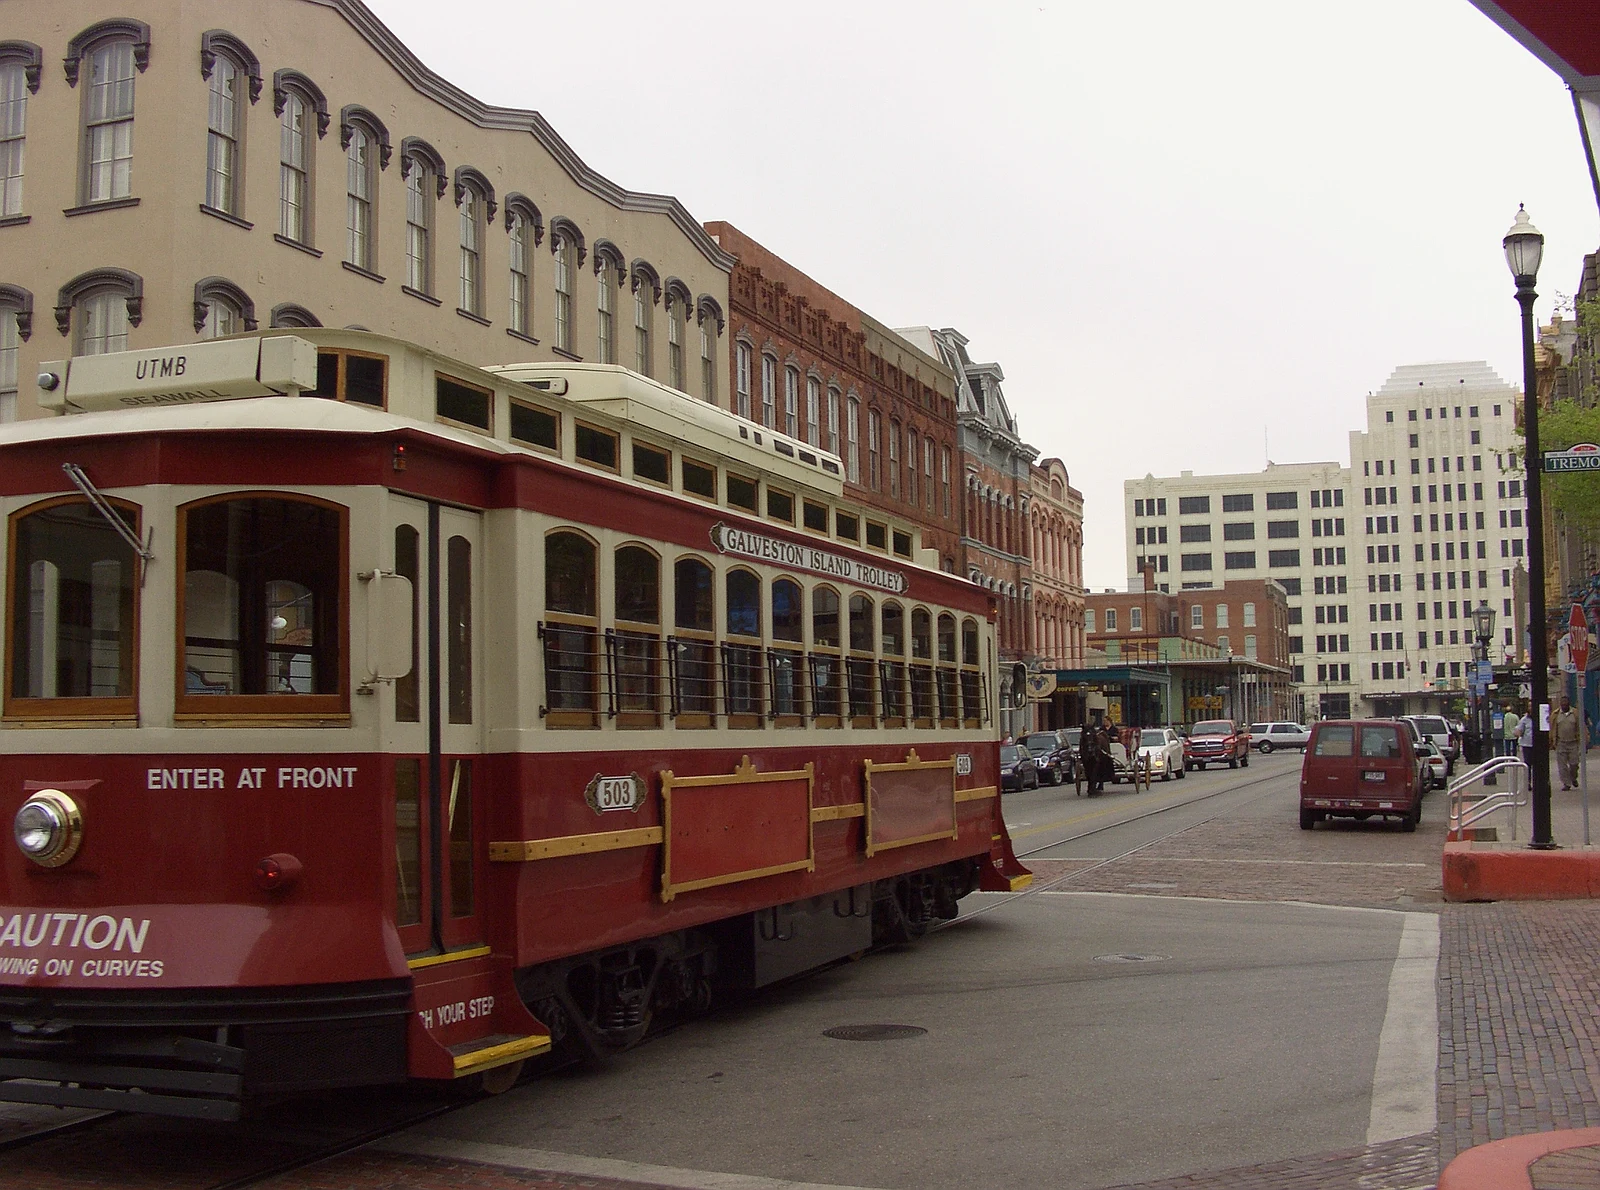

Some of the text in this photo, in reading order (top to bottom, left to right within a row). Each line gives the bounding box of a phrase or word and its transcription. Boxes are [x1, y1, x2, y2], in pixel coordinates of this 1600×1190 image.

[136, 356, 187, 380] UTMB
[120, 389, 231, 405] SEAWALL
[1550, 457, 1600, 469] TREMO
[727, 529, 900, 591] GALVESTON ISLAND TROLLEY
[1570, 626, 1587, 651] STOP
[147, 767, 358, 790] ENTER AT FRONT
[603, 780, 630, 806] 503
[0, 913, 151, 953] AUTION
[45, 958, 74, 976] ON
[81, 959, 165, 978] CURVES
[437, 1002, 466, 1026] YOUR
[469, 996, 495, 1019] STEP
